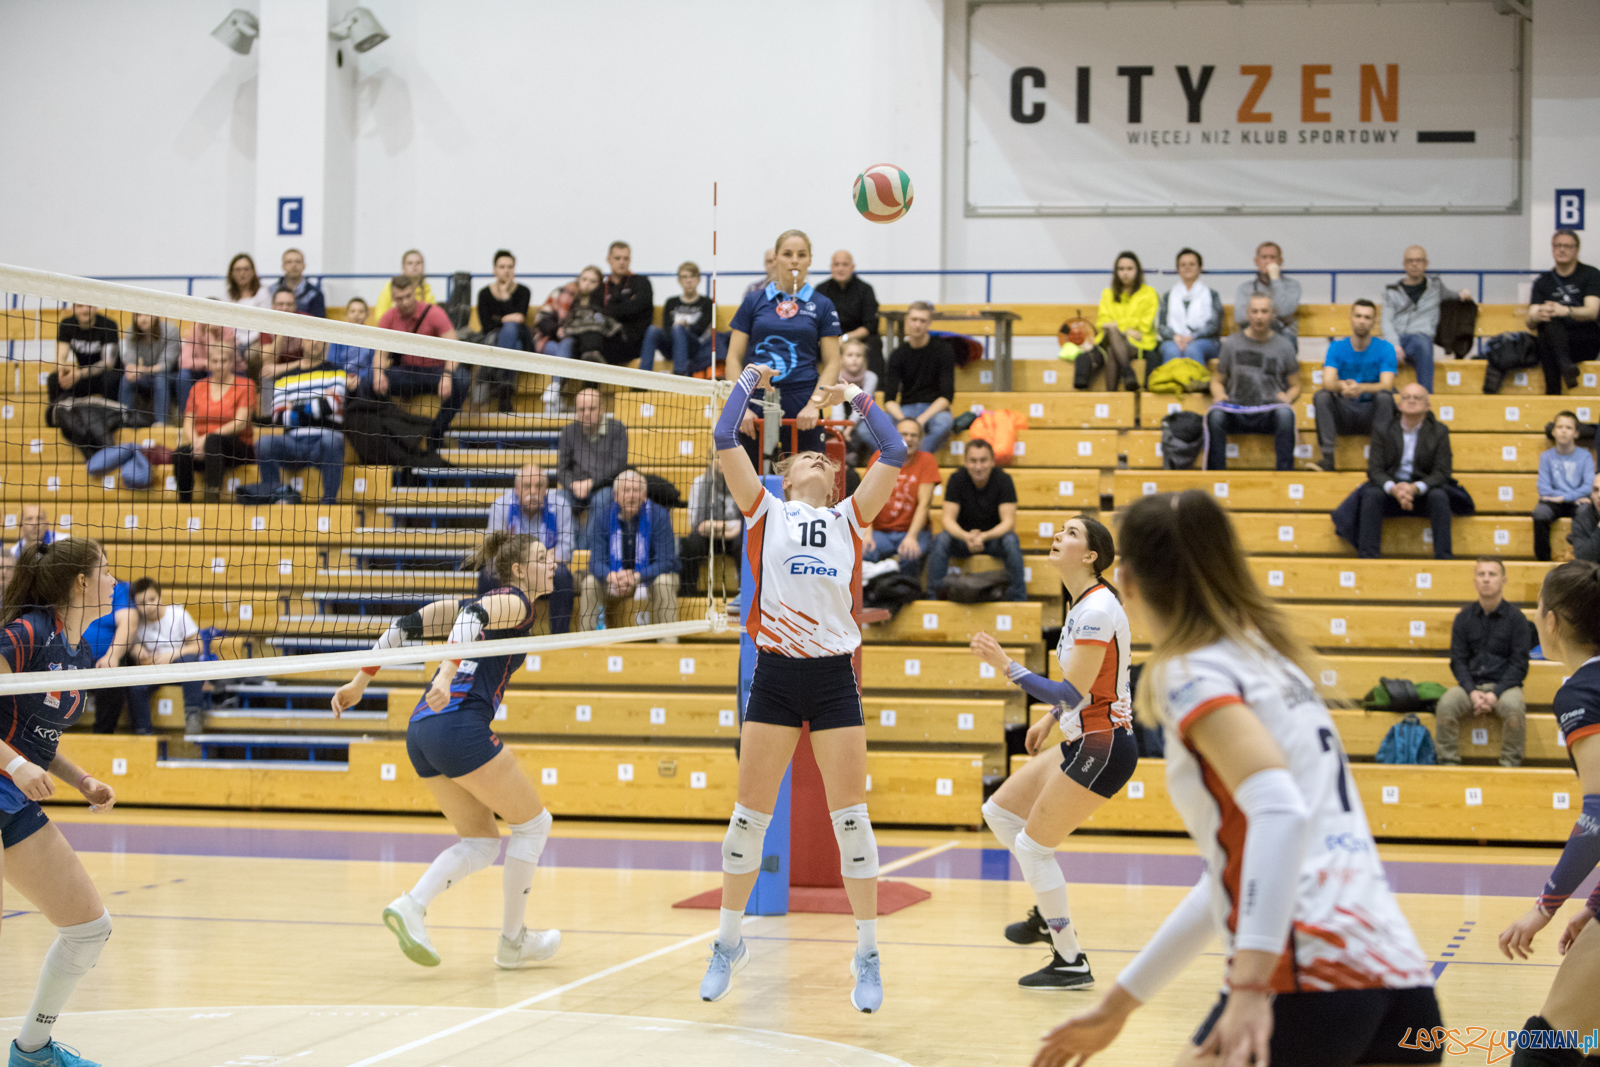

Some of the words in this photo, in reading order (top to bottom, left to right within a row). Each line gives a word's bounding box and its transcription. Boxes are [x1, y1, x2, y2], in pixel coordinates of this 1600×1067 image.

[1010, 63, 1399, 124] CITYZEN
[1127, 129, 1191, 148] WIĘCEJ
[1201, 129, 1231, 145] NIŻ
[1241, 129, 1288, 145] KLUB
[1298, 129, 1400, 145] SPORTOWY
[282, 202, 299, 231] C
[1560, 195, 1579, 224] B
[798, 519, 827, 548] 16
[790, 562, 838, 577] Enea
